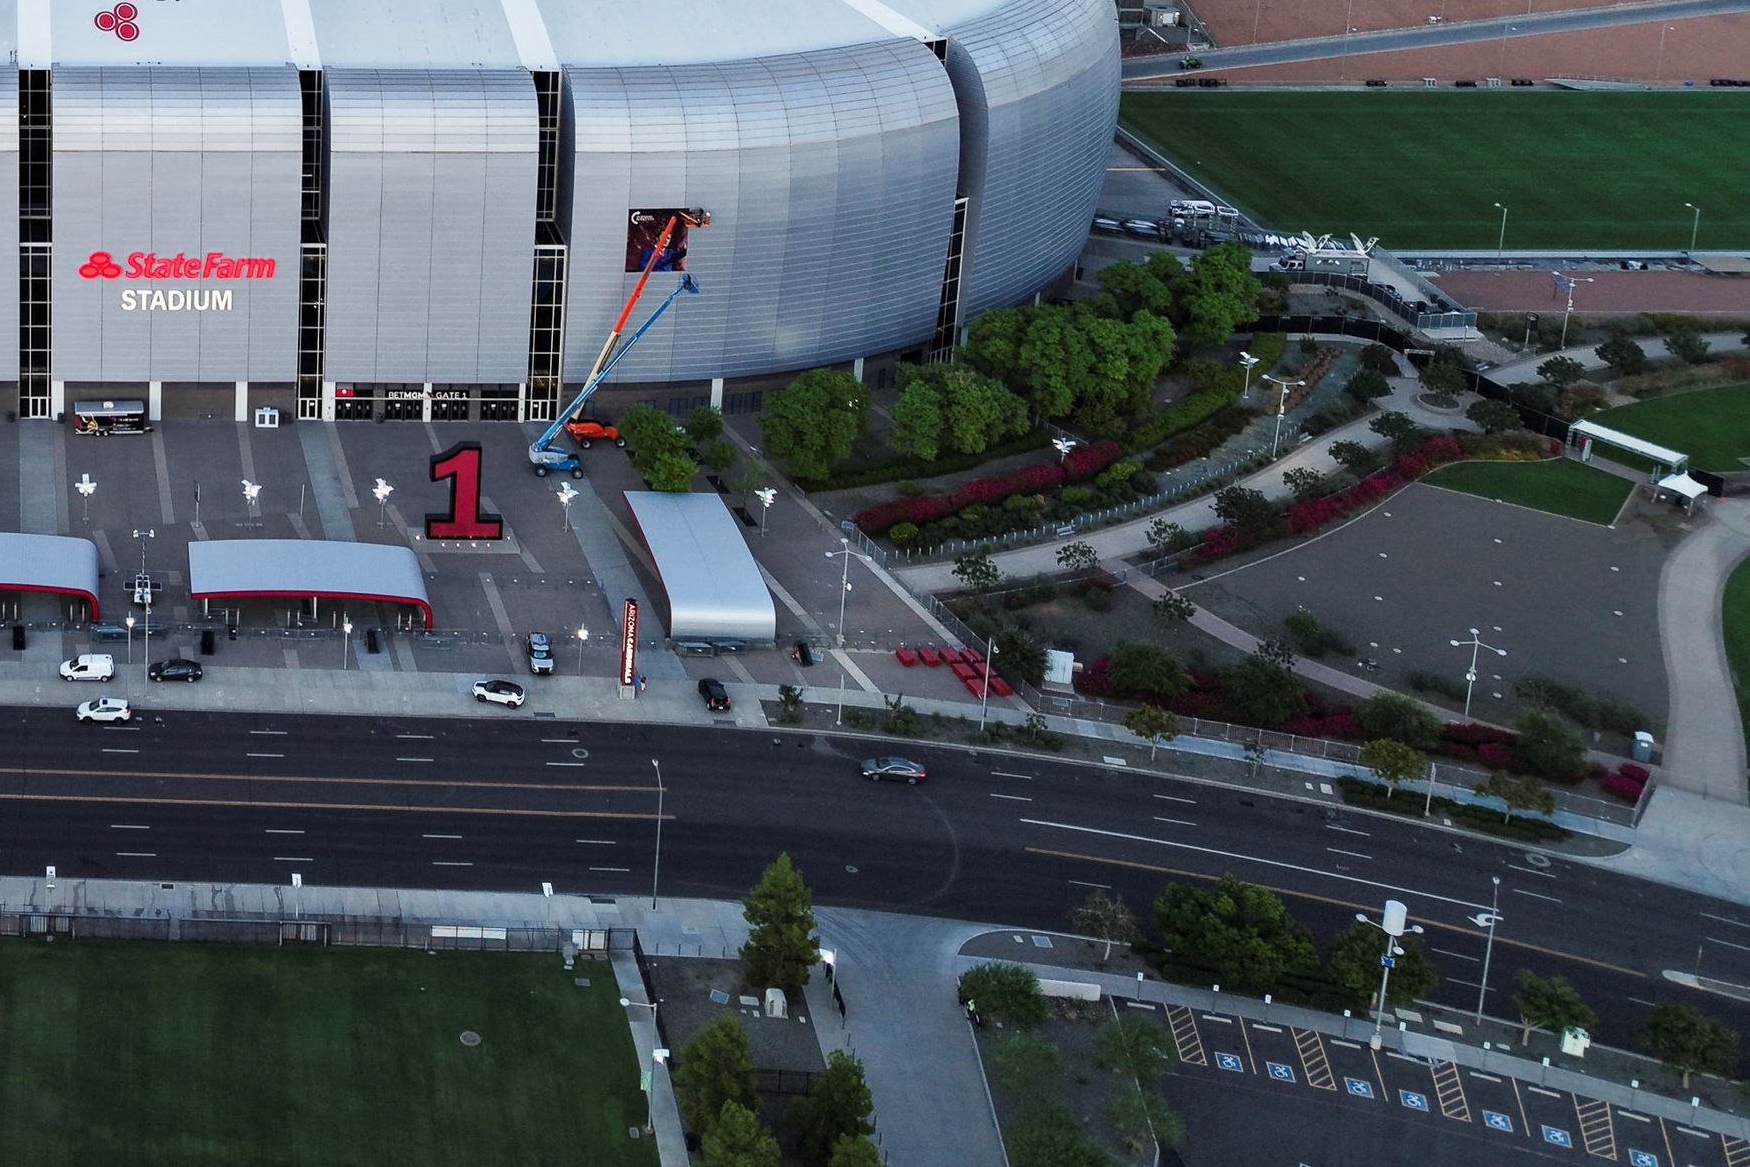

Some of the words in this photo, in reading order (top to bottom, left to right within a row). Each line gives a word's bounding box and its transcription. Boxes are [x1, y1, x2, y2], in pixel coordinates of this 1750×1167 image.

[121, 289, 233, 311] STADIUM
[435, 391, 460, 399] GATE
[462, 391, 467, 399] 1
[425, 441, 503, 540] 1
